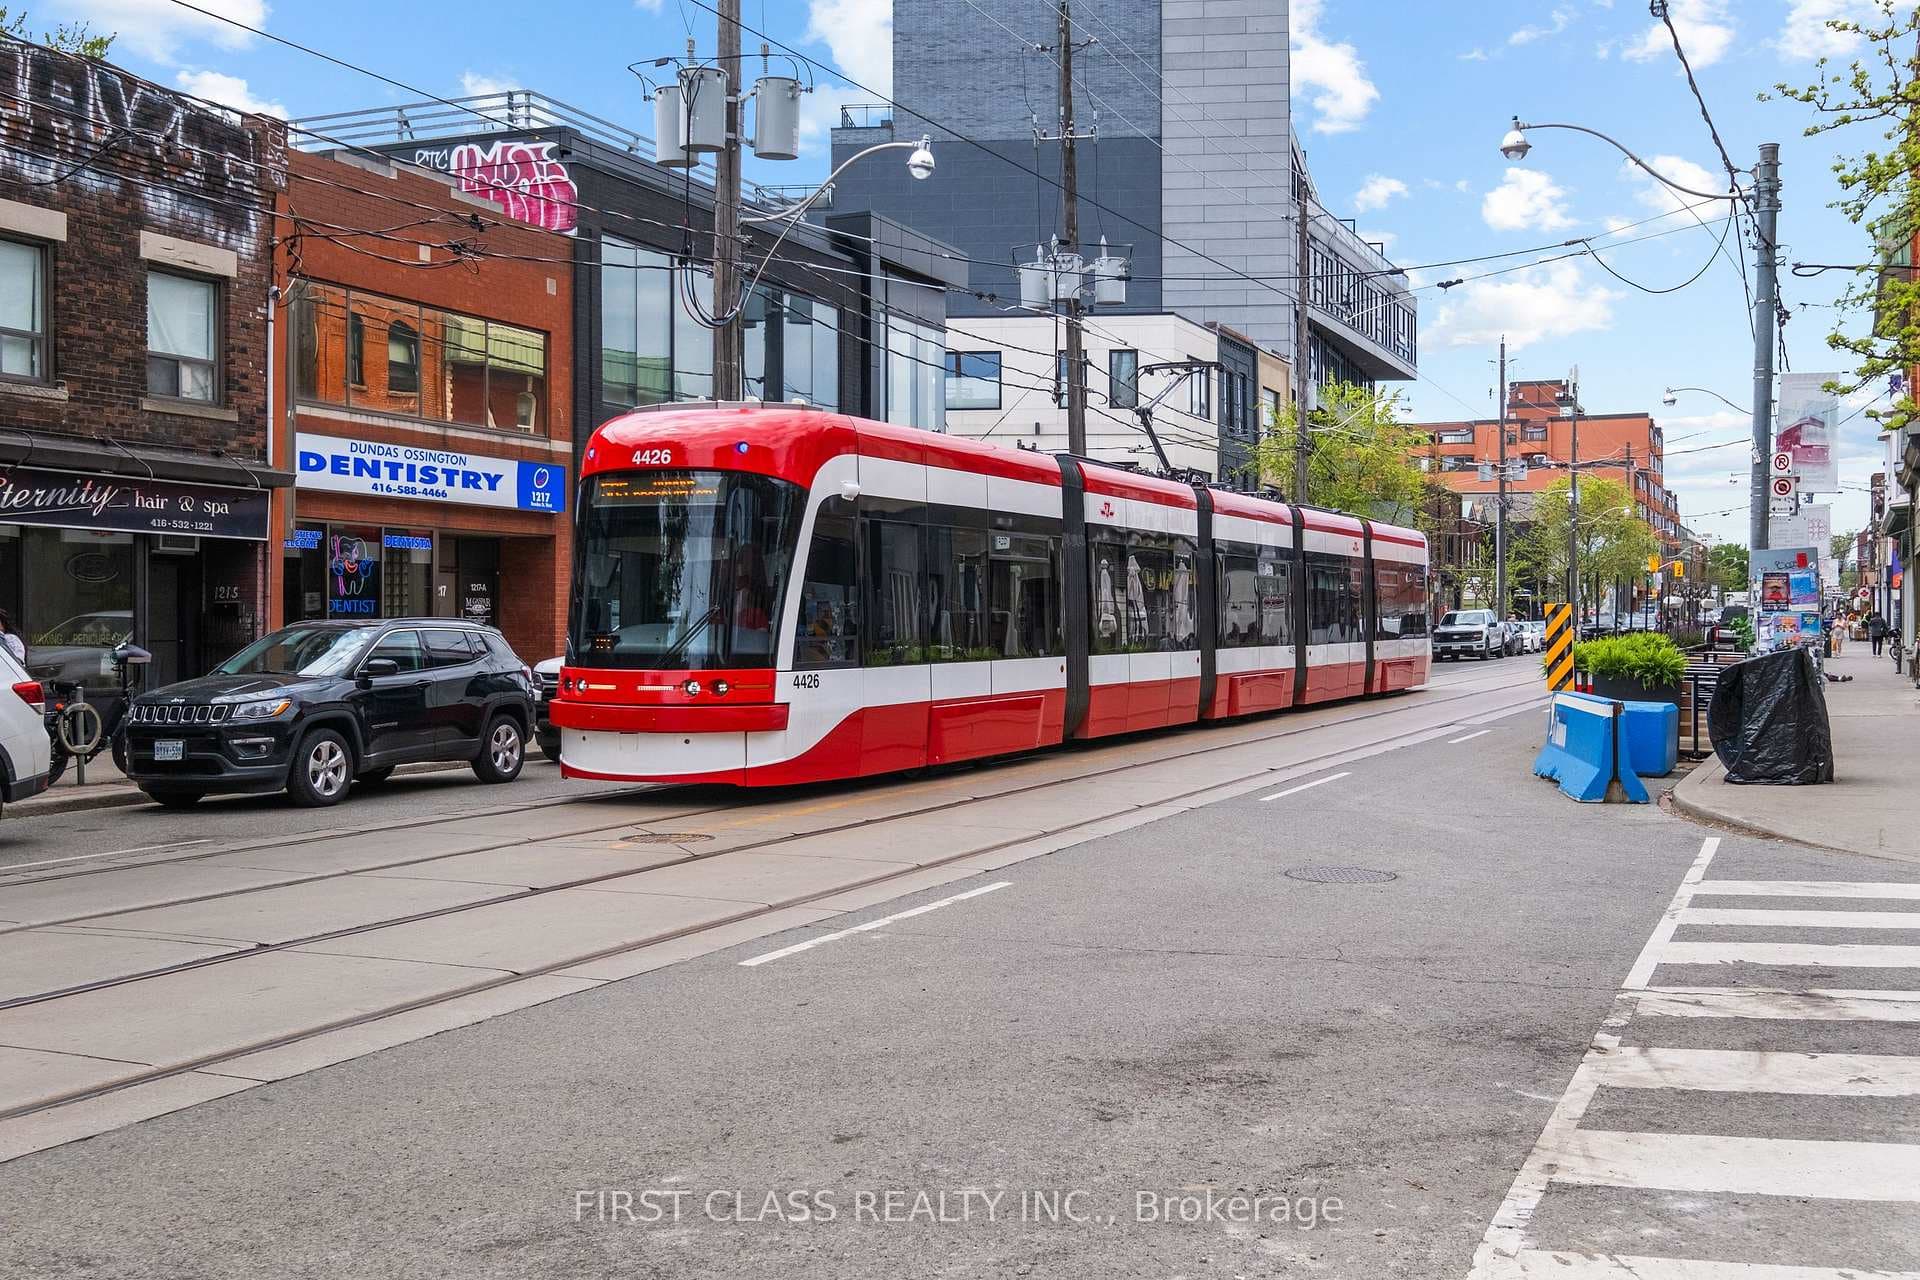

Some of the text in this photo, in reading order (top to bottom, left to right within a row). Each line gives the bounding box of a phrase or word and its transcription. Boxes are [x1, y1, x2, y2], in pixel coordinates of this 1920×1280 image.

[350, 442, 468, 466] DUNDAS OSSINGTON
[631, 449, 672, 465] 4426
[299, 451, 504, 493] DENTISTRY
[371, 482, 448, 499] 416-588-4466
[532, 491, 551, 502] 1217
[135, 490, 169, 510] hair
[178, 495, 195, 512] &
[203, 499, 229, 517] spa
[384, 535, 432, 550] DENTISTA
[214, 586, 239, 600] 1215
[329, 599, 376, 614] DENTIST
[793, 673, 820, 689] 4426
